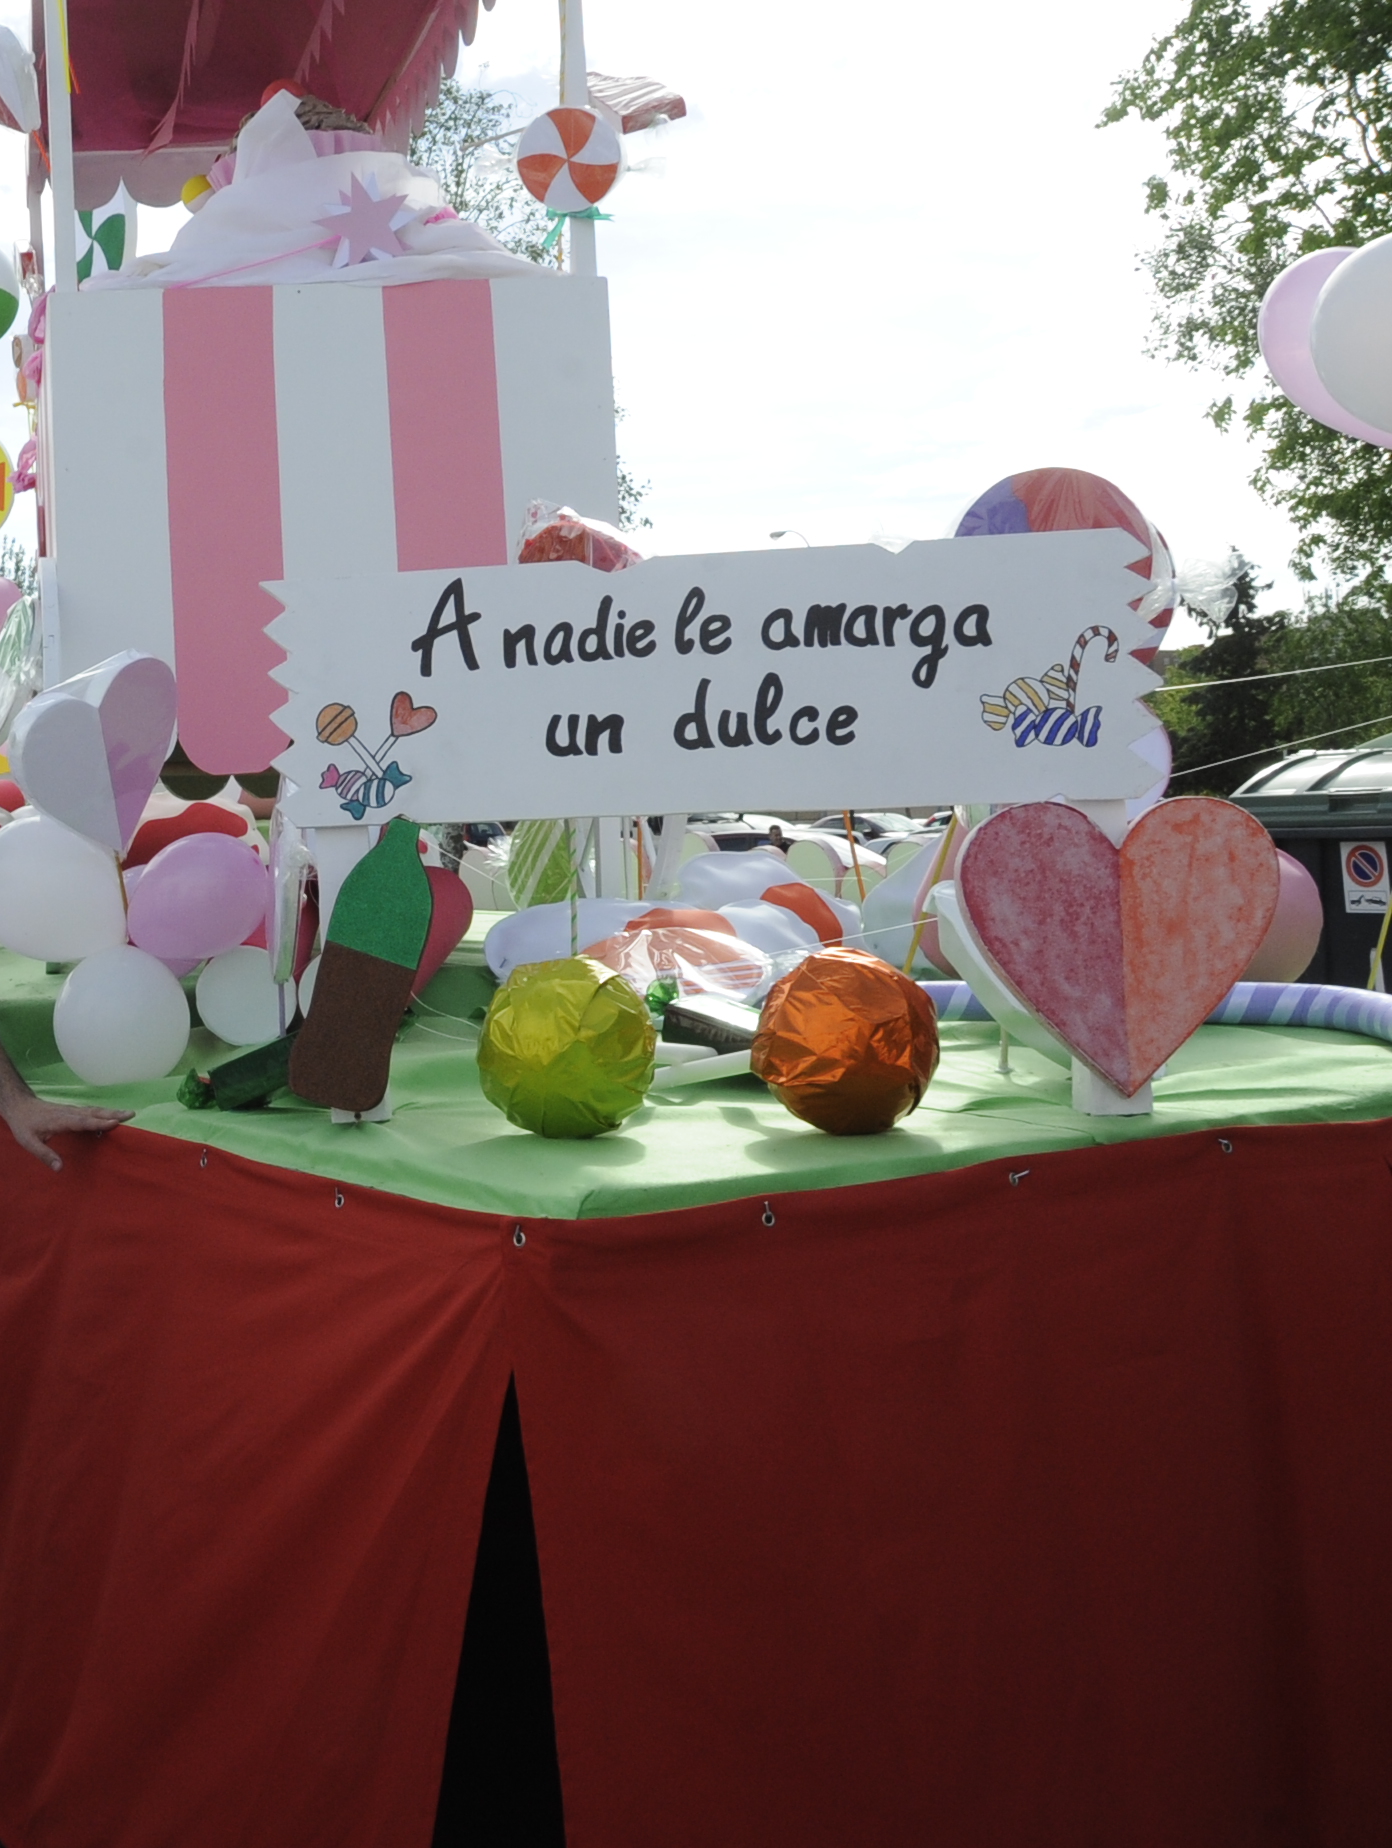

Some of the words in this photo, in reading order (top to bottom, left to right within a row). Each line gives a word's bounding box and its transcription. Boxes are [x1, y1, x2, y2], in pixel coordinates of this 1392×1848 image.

[411, 577, 482, 678] A
[503, 594, 657, 670] nadie
[674, 586, 733, 656] le
[761, 602, 994, 690] amarga
[545, 712, 625, 758] un
[673, 672, 859, 751] dulce
